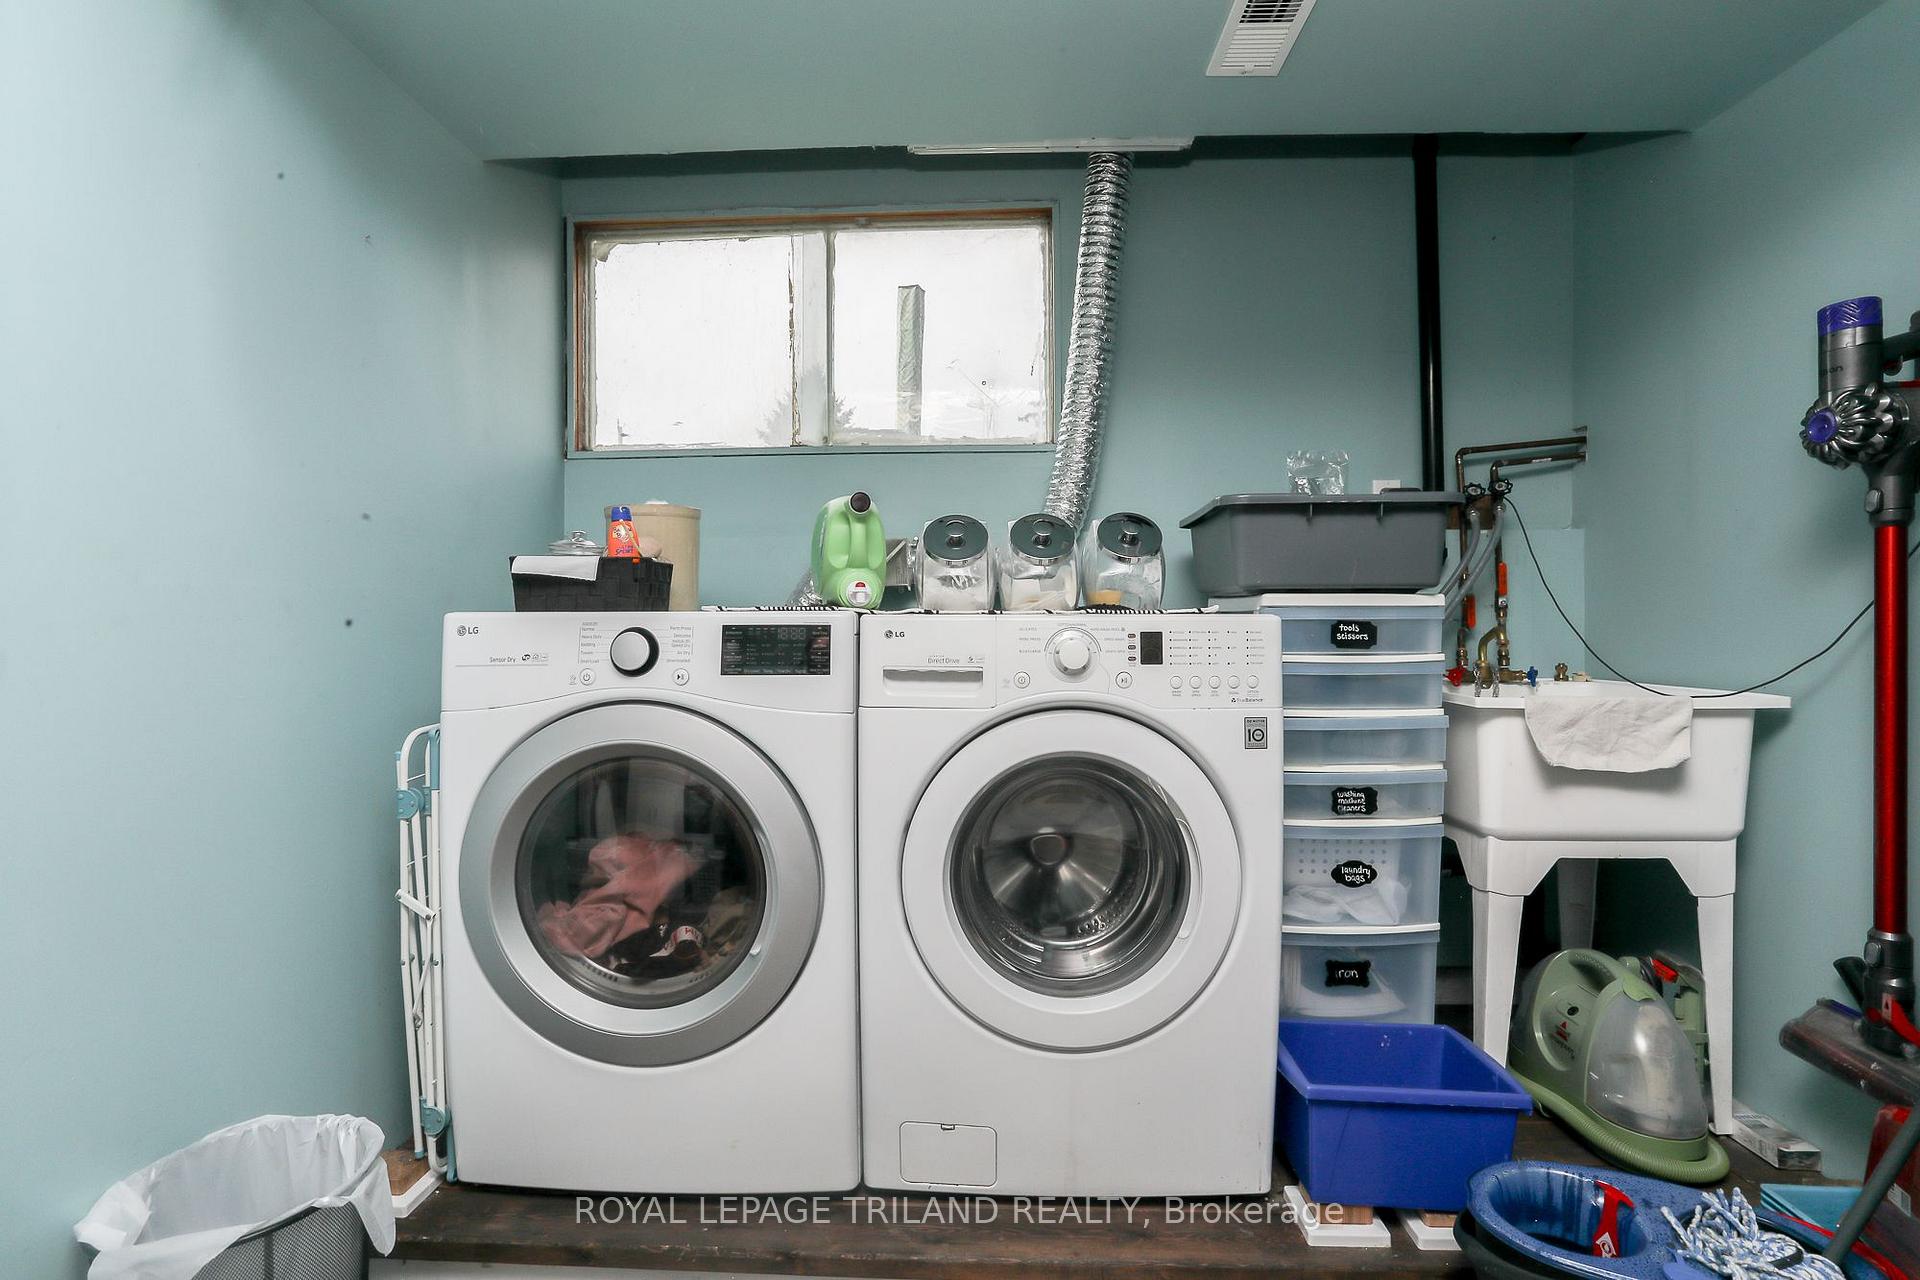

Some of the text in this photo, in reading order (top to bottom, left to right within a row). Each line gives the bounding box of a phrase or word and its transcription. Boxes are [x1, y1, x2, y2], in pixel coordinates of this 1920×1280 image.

[1339, 623, 1360, 633] tools
[1336, 632, 1369, 641] scissors
[1337, 790, 1366, 800] washing
[1341, 865, 1371, 879] laundry
[1344, 874, 1366, 884] bags
